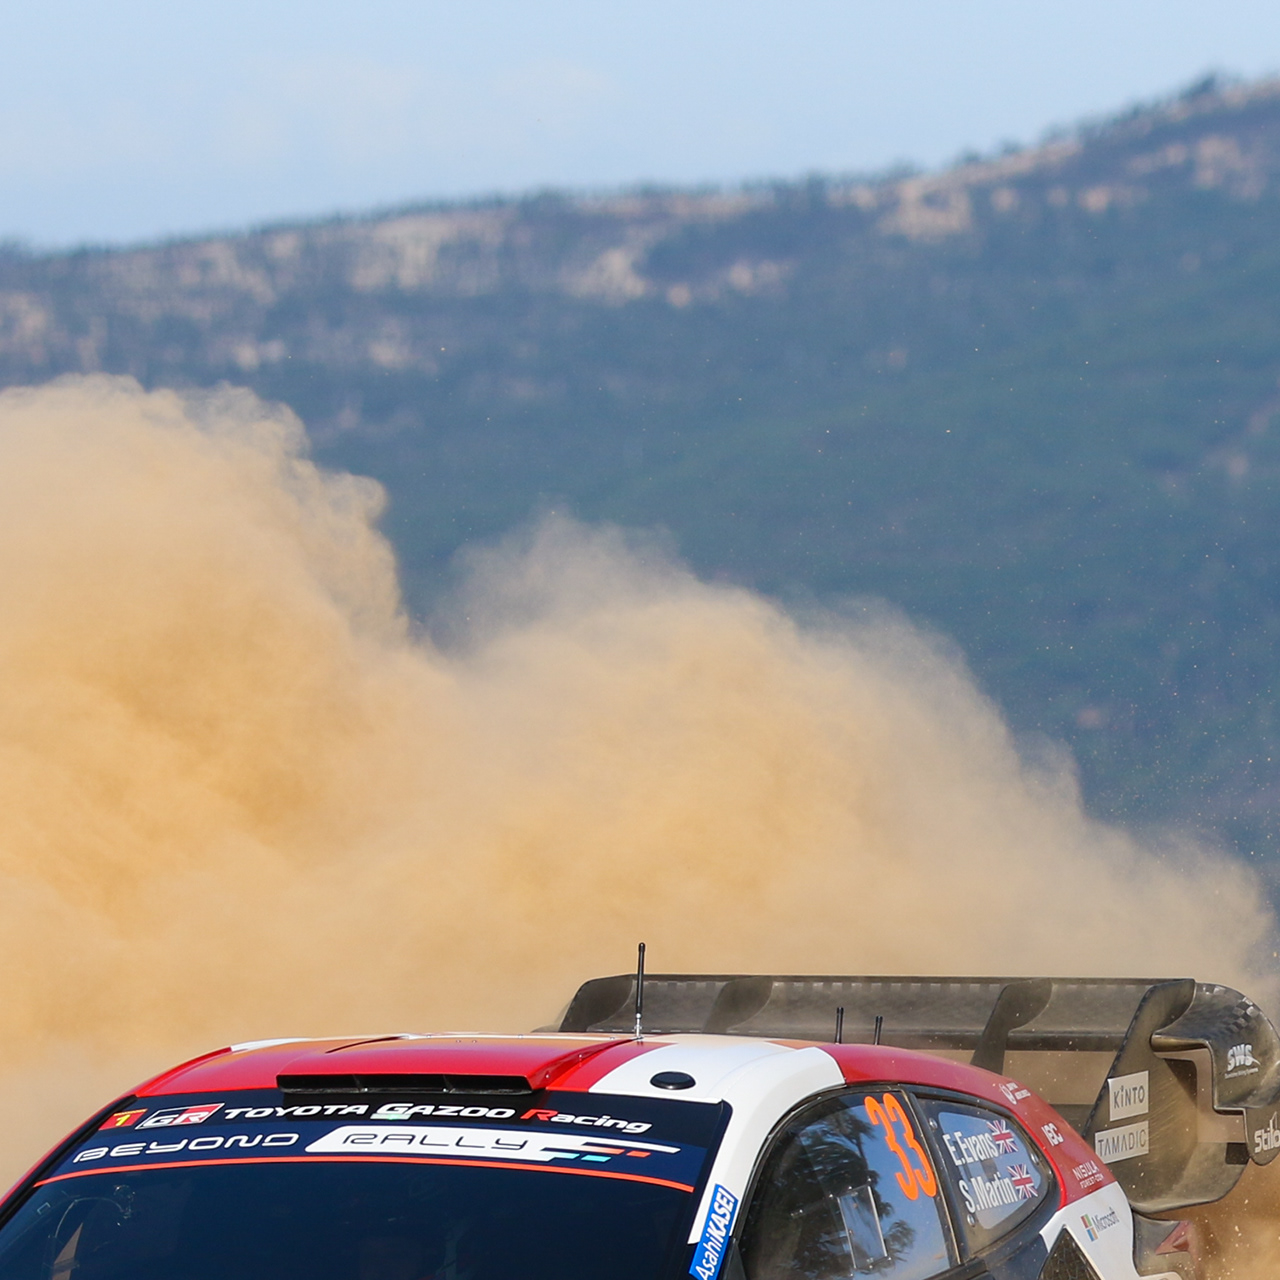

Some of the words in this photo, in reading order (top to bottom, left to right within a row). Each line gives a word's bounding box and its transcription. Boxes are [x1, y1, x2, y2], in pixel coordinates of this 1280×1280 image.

[1227, 1043, 1254, 1071] SWS
[139, 1108, 215, 1128] GR
[224, 1104, 369, 1120] TOYOTA
[376, 1103, 516, 1120] GAZOO
[520, 1108, 652, 1133] Racing
[72, 1133, 300, 1163] BEYOND
[343, 1133, 528, 1150] RALLY
[864, 1093, 937, 1200] 33
[942, 1131, 999, 1166] E.Evans
[1097, 1129, 1147, 1157] TAMADIC
[1254, 1117, 1280, 1153] Stilo
[1072, 1160, 1099, 1180] NISULA
[959, 1172, 1018, 1214] S.Martin
[1091, 1206, 1120, 1233] Microsoft
